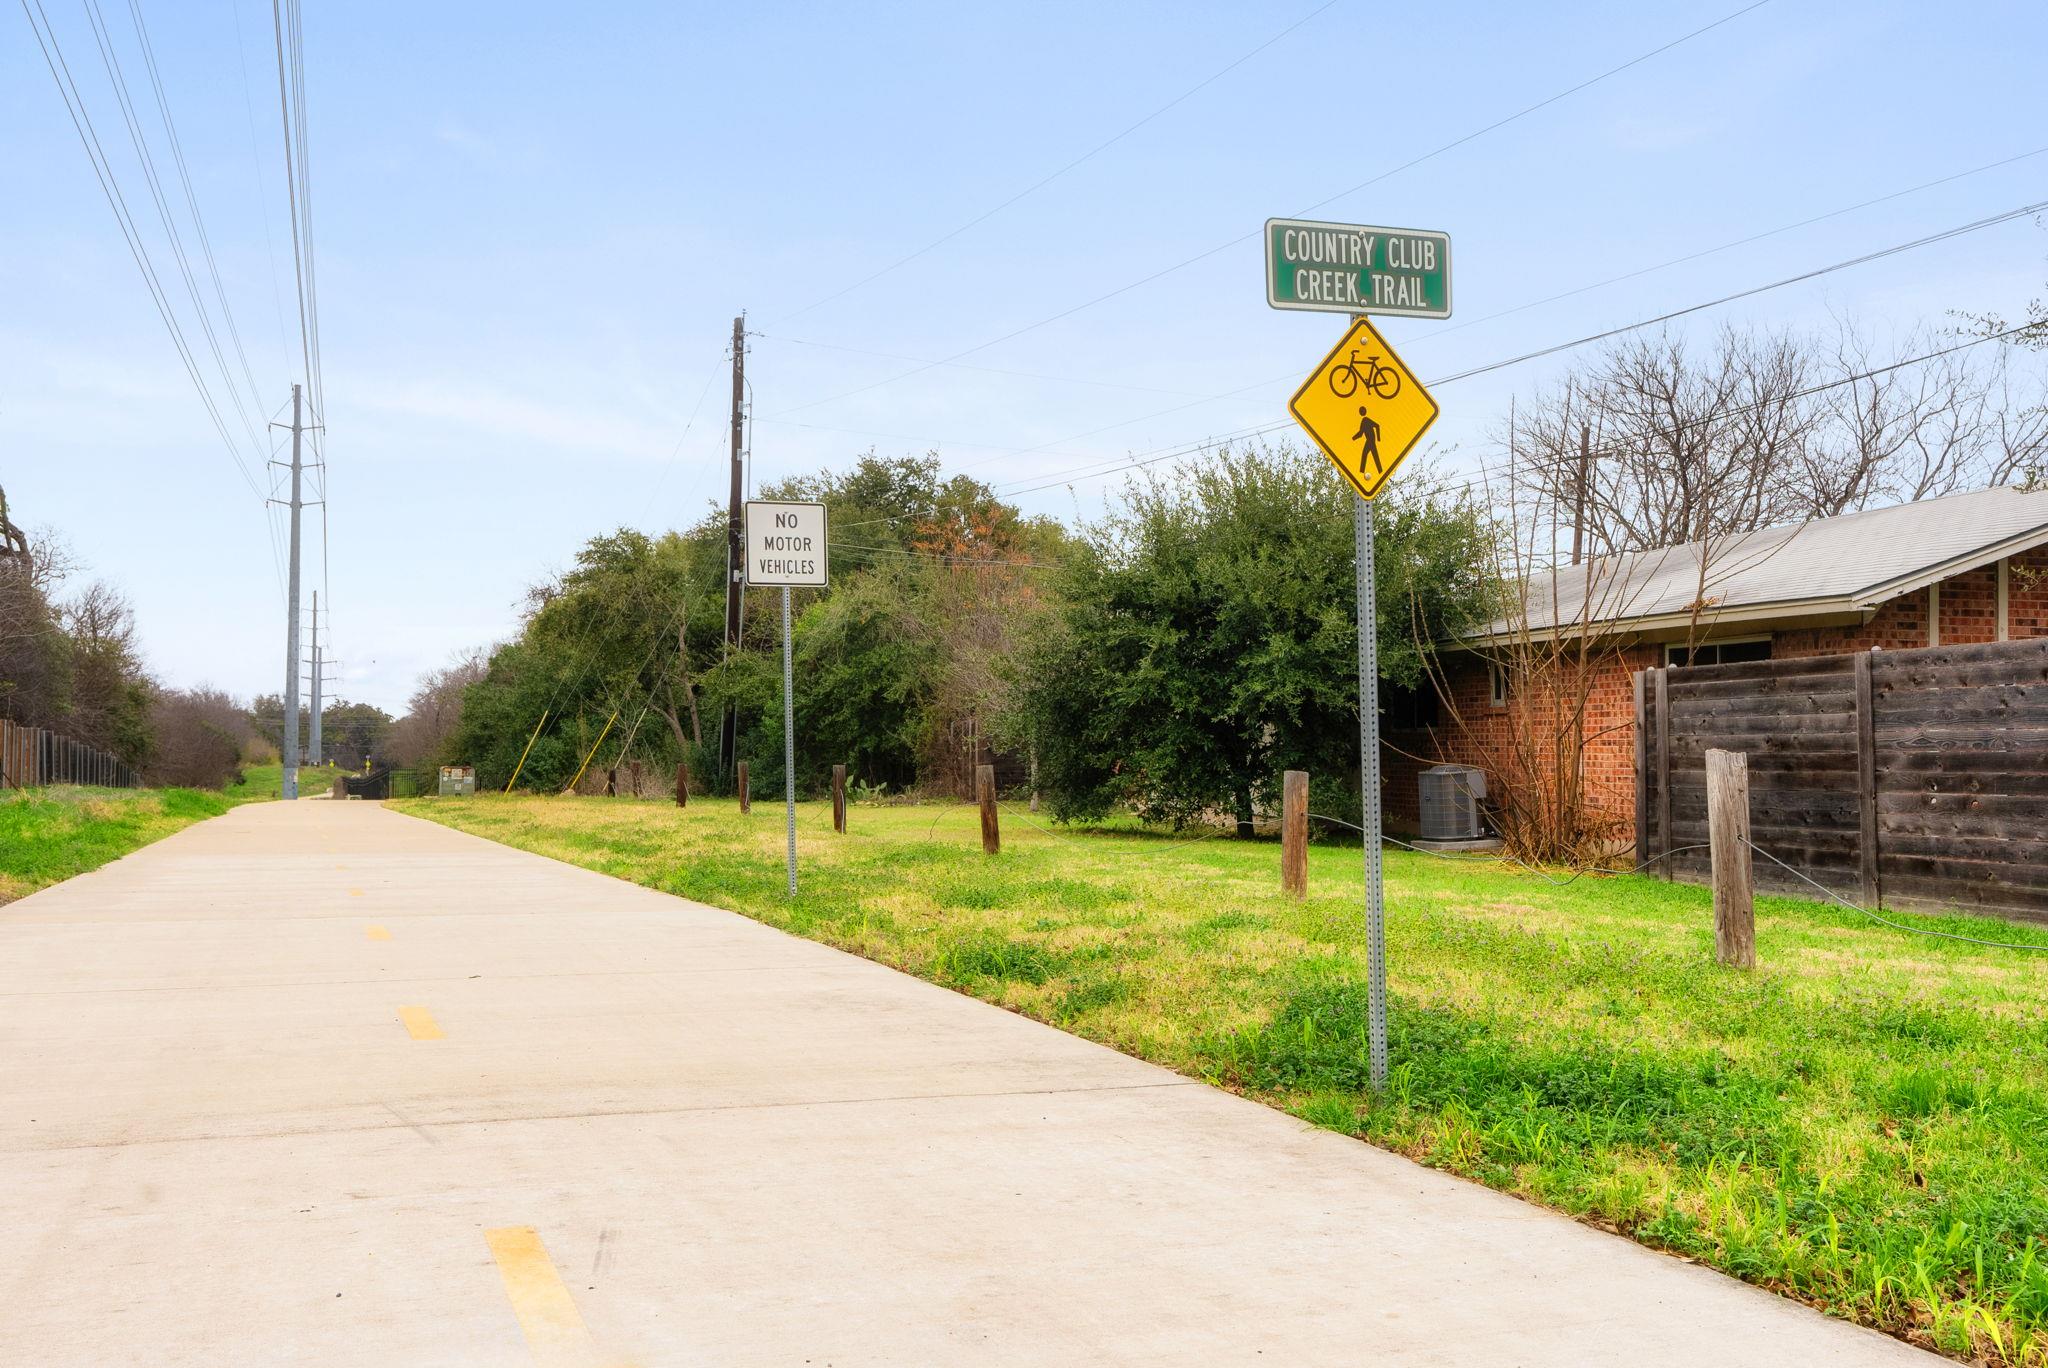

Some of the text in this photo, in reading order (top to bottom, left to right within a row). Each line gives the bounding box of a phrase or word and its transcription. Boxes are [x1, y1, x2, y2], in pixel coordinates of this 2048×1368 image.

[1284, 229, 1436, 271] COUNTRY CLUB
[1296, 269, 1427, 308] CREEK TRAIL
[775, 513, 798, 529] NO
[764, 536, 812, 552] MOTOR
[759, 558, 815, 575] VEHICLES
